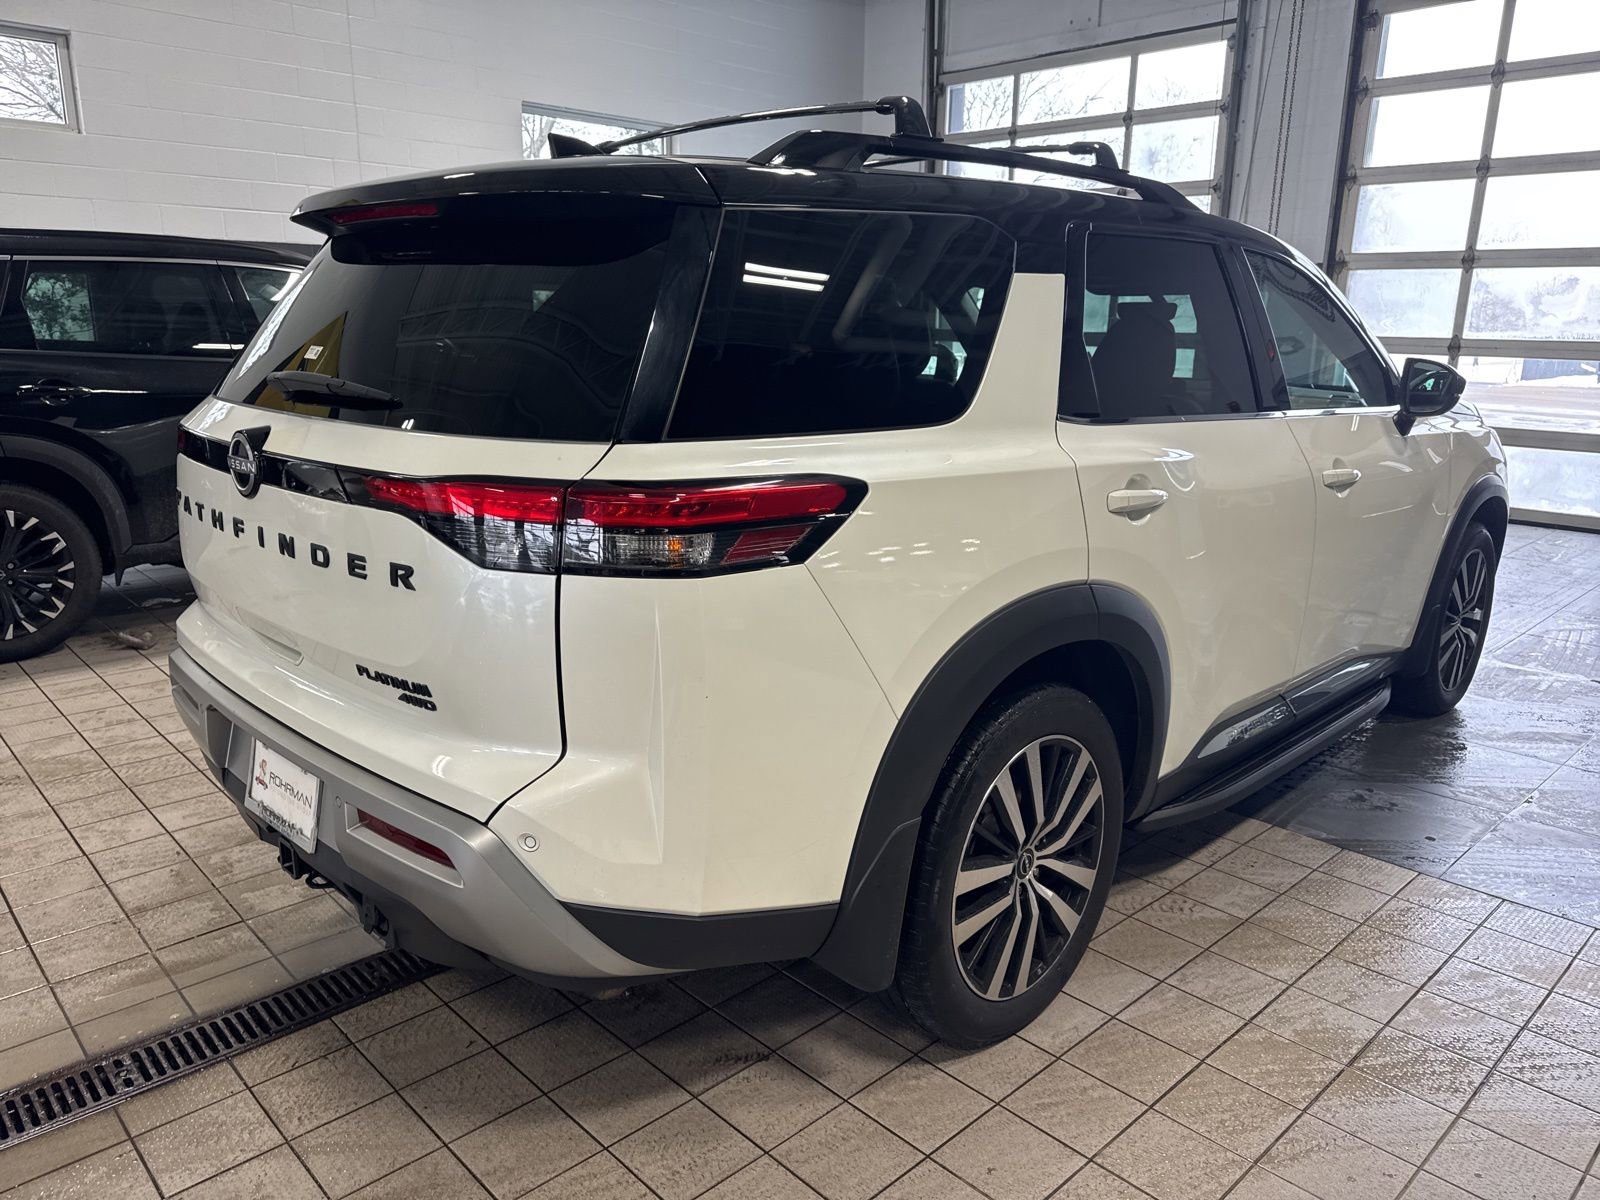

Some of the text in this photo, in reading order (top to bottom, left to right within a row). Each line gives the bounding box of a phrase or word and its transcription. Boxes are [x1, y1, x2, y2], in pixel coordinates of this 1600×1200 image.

[230, 458, 255, 473] SSAN
[355, 663, 433, 698] PLATINUM
[398, 693, 437, 711] 4WD
[269, 772, 312, 809] ROHRMAN
